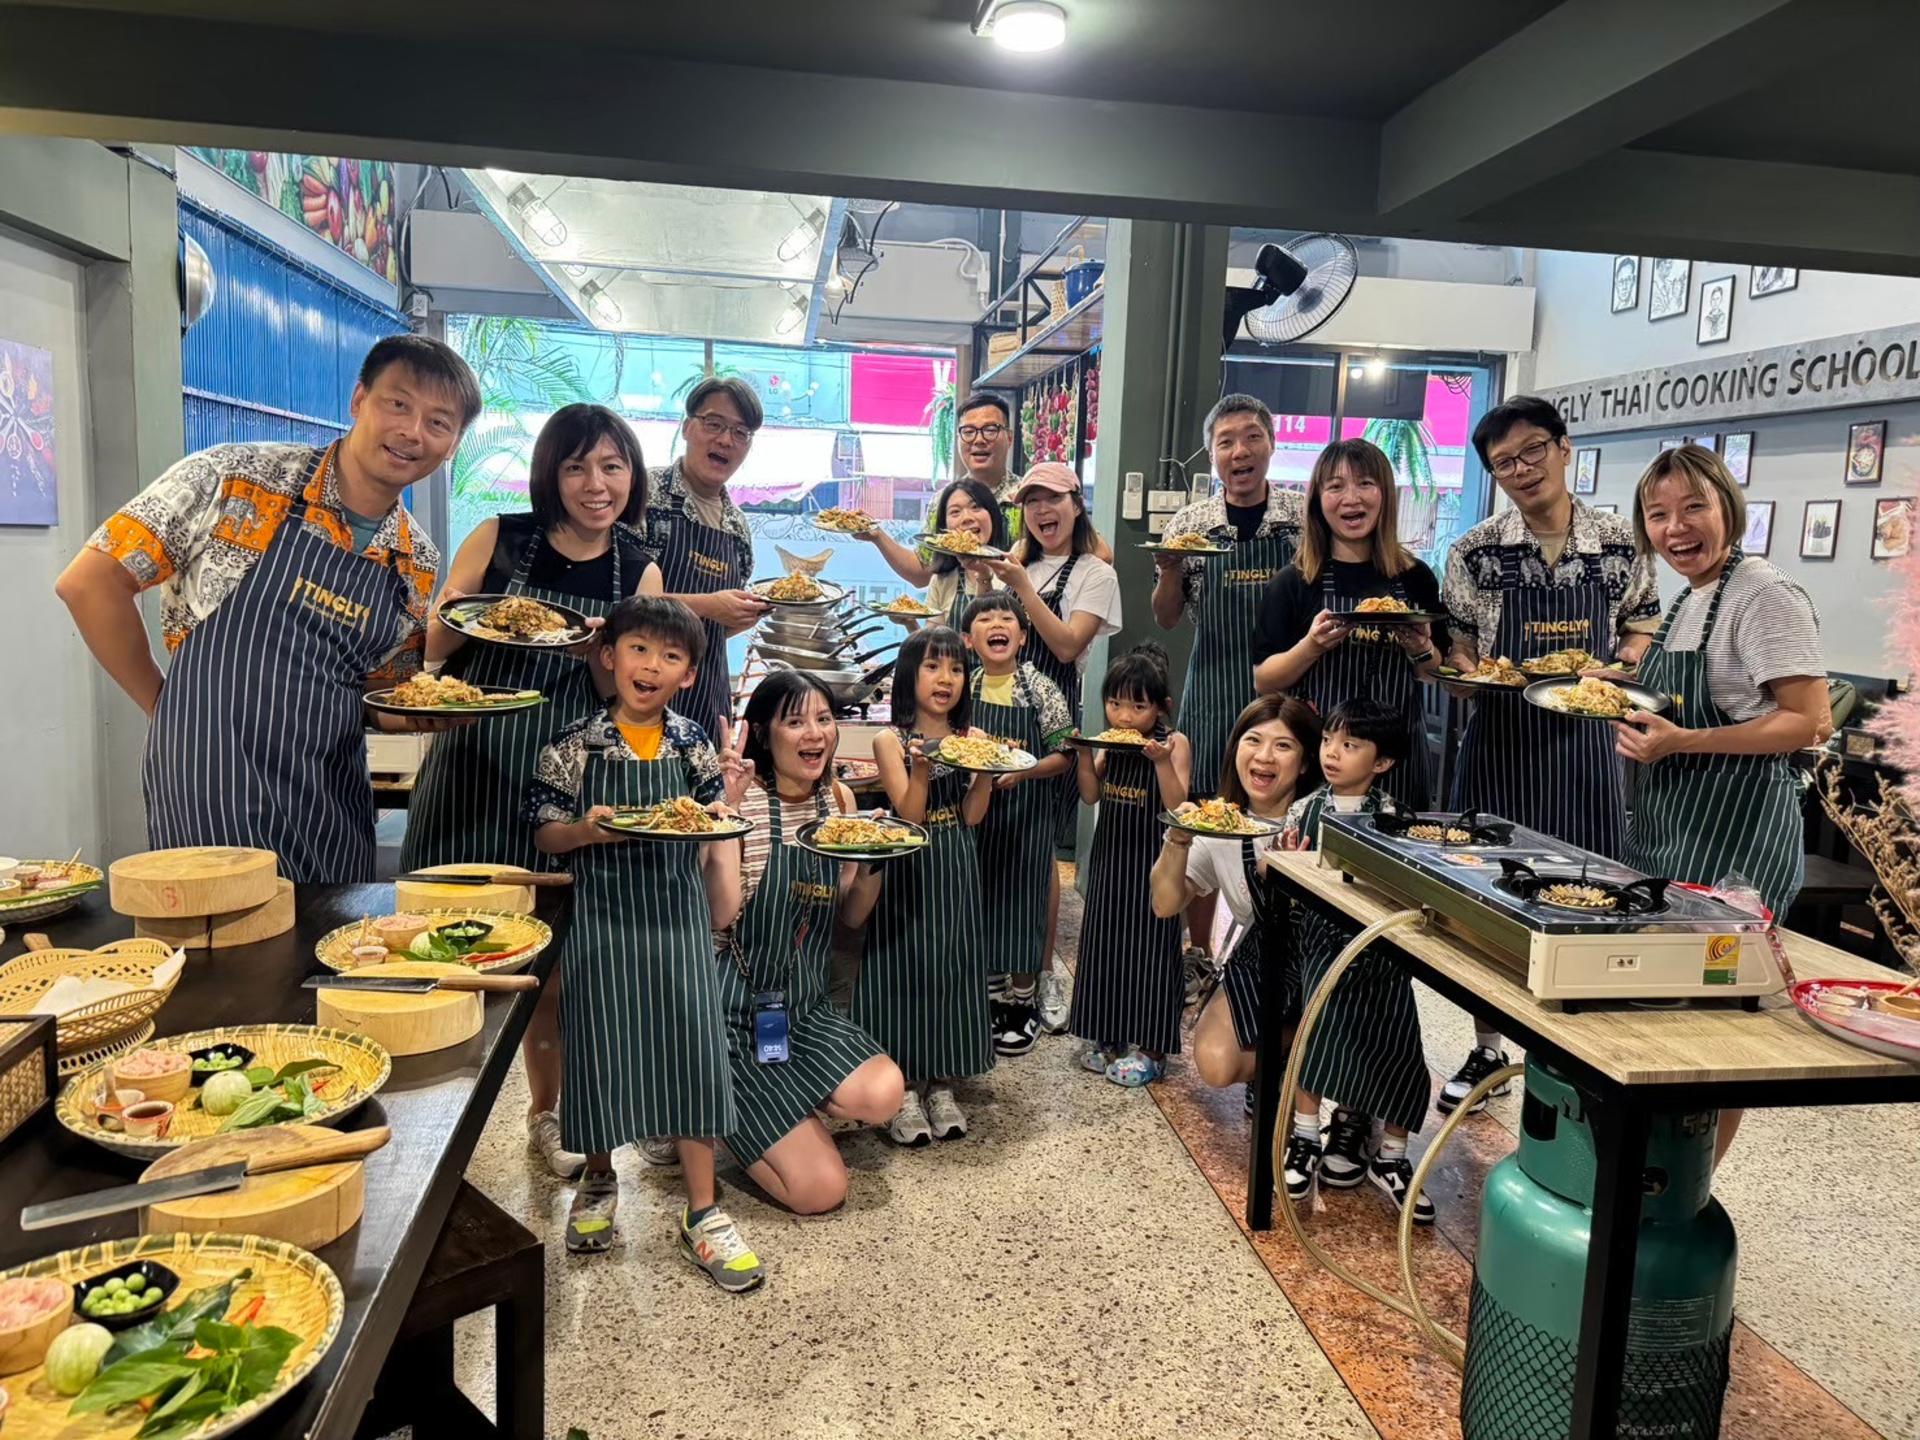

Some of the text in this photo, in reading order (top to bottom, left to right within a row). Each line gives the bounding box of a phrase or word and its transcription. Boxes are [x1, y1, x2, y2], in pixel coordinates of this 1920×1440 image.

[1552, 340, 1920, 423] GLY THAI COOKING SCHOOL
[1230, 569, 1271, 581] TINGLY
[305, 580, 364, 618] TINGLY
[1531, 620, 1584, 634] TINGLY
